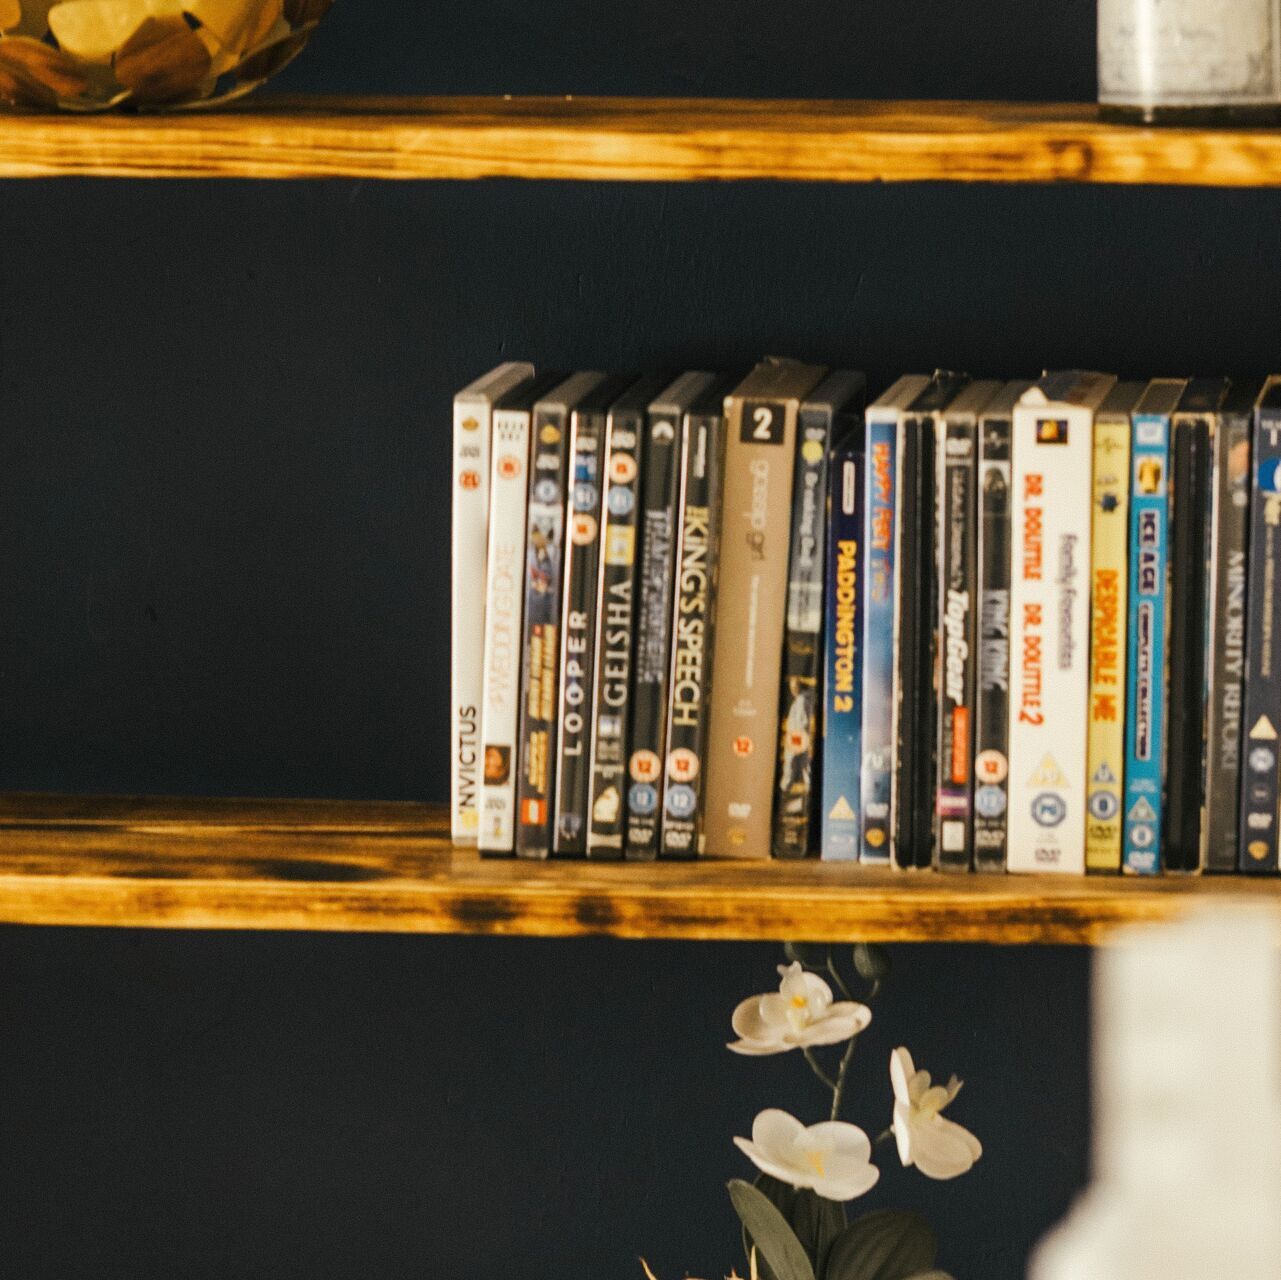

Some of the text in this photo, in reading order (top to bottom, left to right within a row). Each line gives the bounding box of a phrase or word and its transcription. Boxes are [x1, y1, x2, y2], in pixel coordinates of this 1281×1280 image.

[753, 408, 772, 439] 2
[1023, 473, 1043, 581] DR. DOLITTLE
[1141, 512, 1156, 592] ICE AGE
[564, 610, 588, 756] LOOPER
[603, 580, 632, 707] GEISHA
[673, 617, 704, 726] SPEECH
[1019, 603, 1044, 726] DR. DOLITTLE 2
[1092, 569, 1118, 721] DESPICABLE ME
[1221, 550, 1245, 770] MINORITY REPORT
[834, 696, 854, 712] 2
[458, 705, 477, 815] NVICTUS
